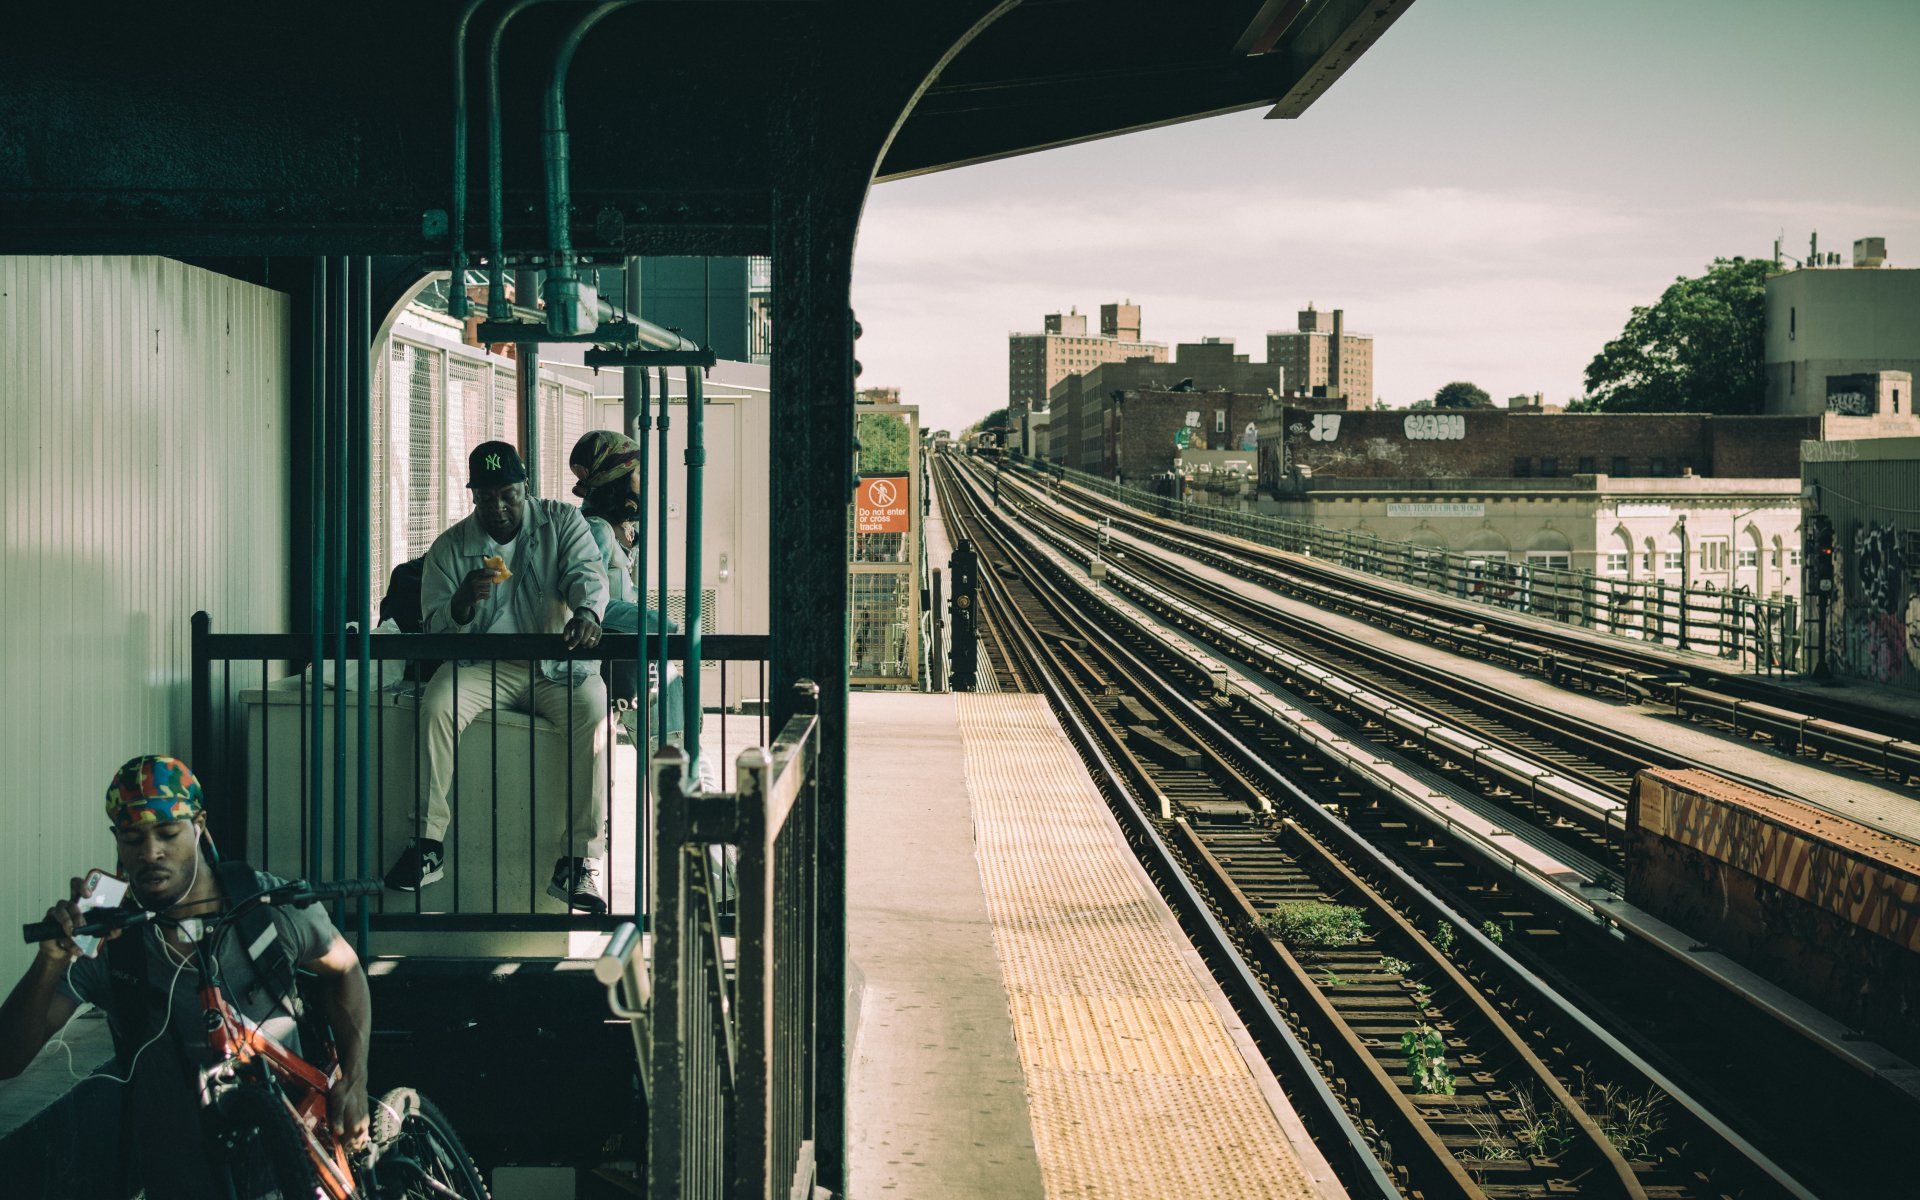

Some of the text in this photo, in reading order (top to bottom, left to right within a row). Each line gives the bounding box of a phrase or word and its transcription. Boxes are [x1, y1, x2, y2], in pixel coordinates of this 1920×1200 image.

[485, 453, 501, 471] NY
[859, 508, 906, 516] Do not enter
[1413, 504, 1437, 512] TEMPLE
[859, 523, 883, 531] tracks
